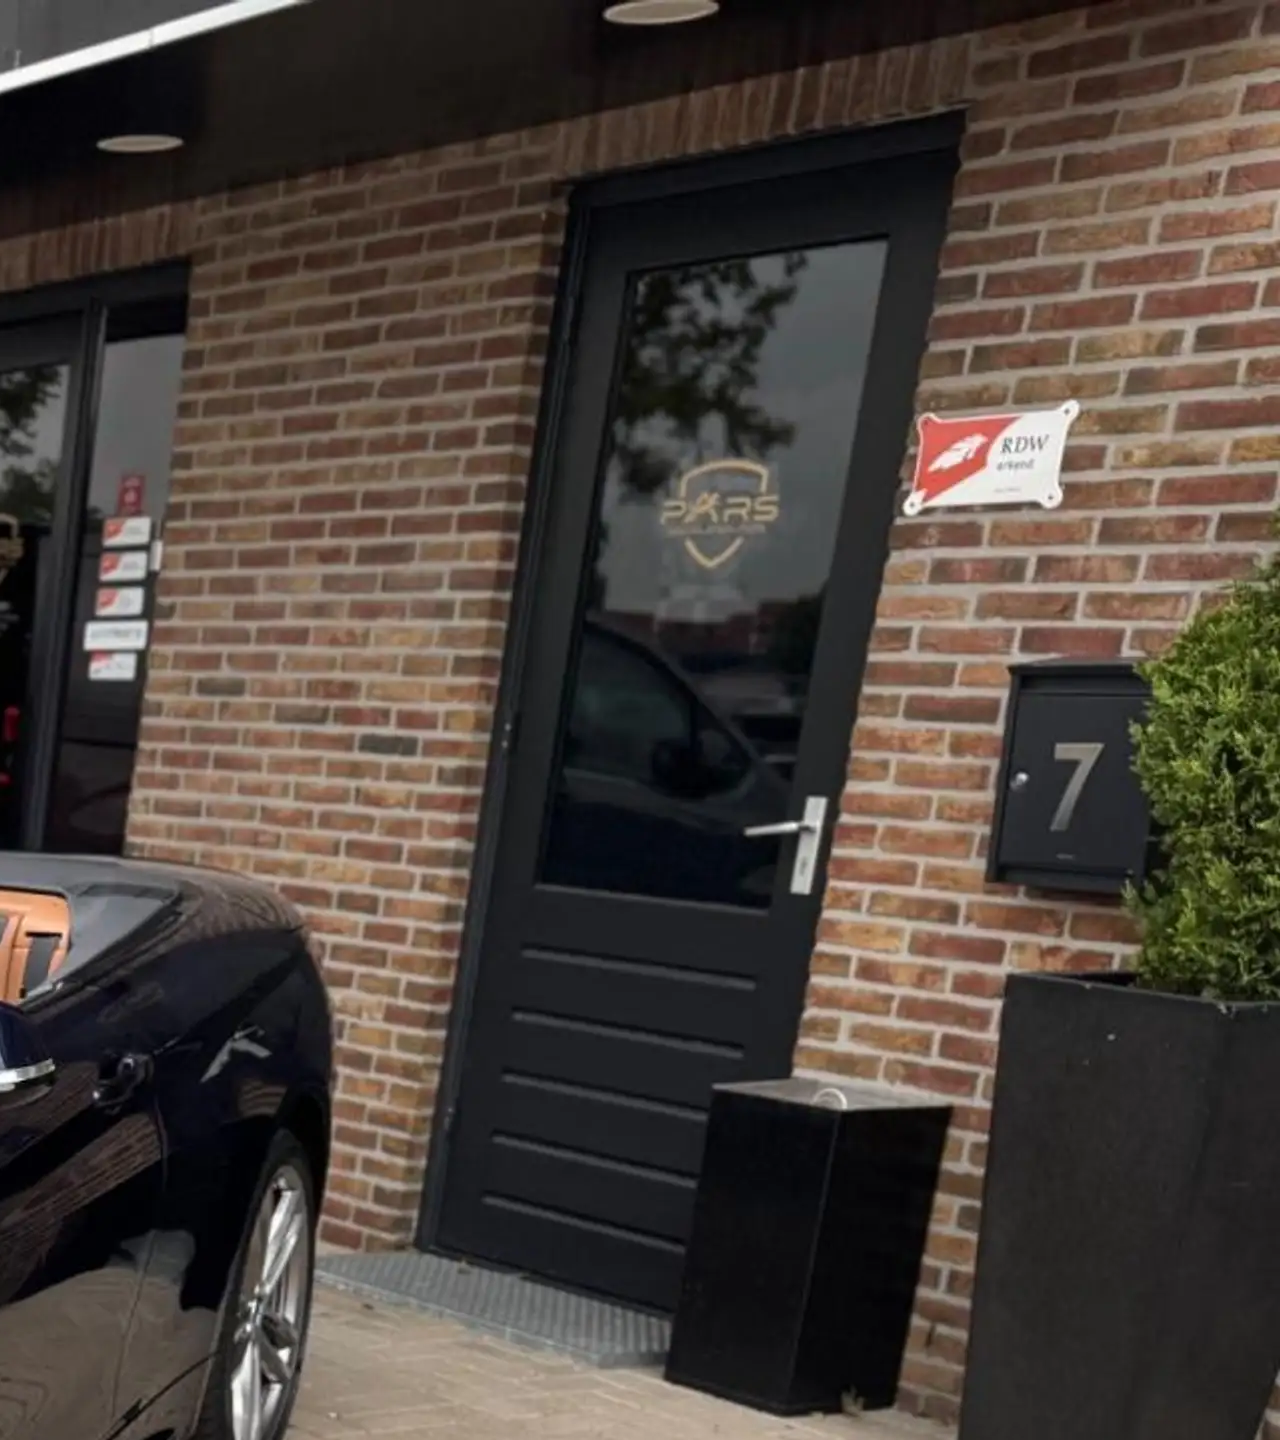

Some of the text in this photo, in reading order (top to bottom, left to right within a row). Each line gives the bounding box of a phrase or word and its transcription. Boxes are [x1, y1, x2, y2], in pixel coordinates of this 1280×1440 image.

[1000, 434, 1049, 454] RDW
[660, 491, 779, 525] PARS
[1050, 742, 1105, 832] 7
